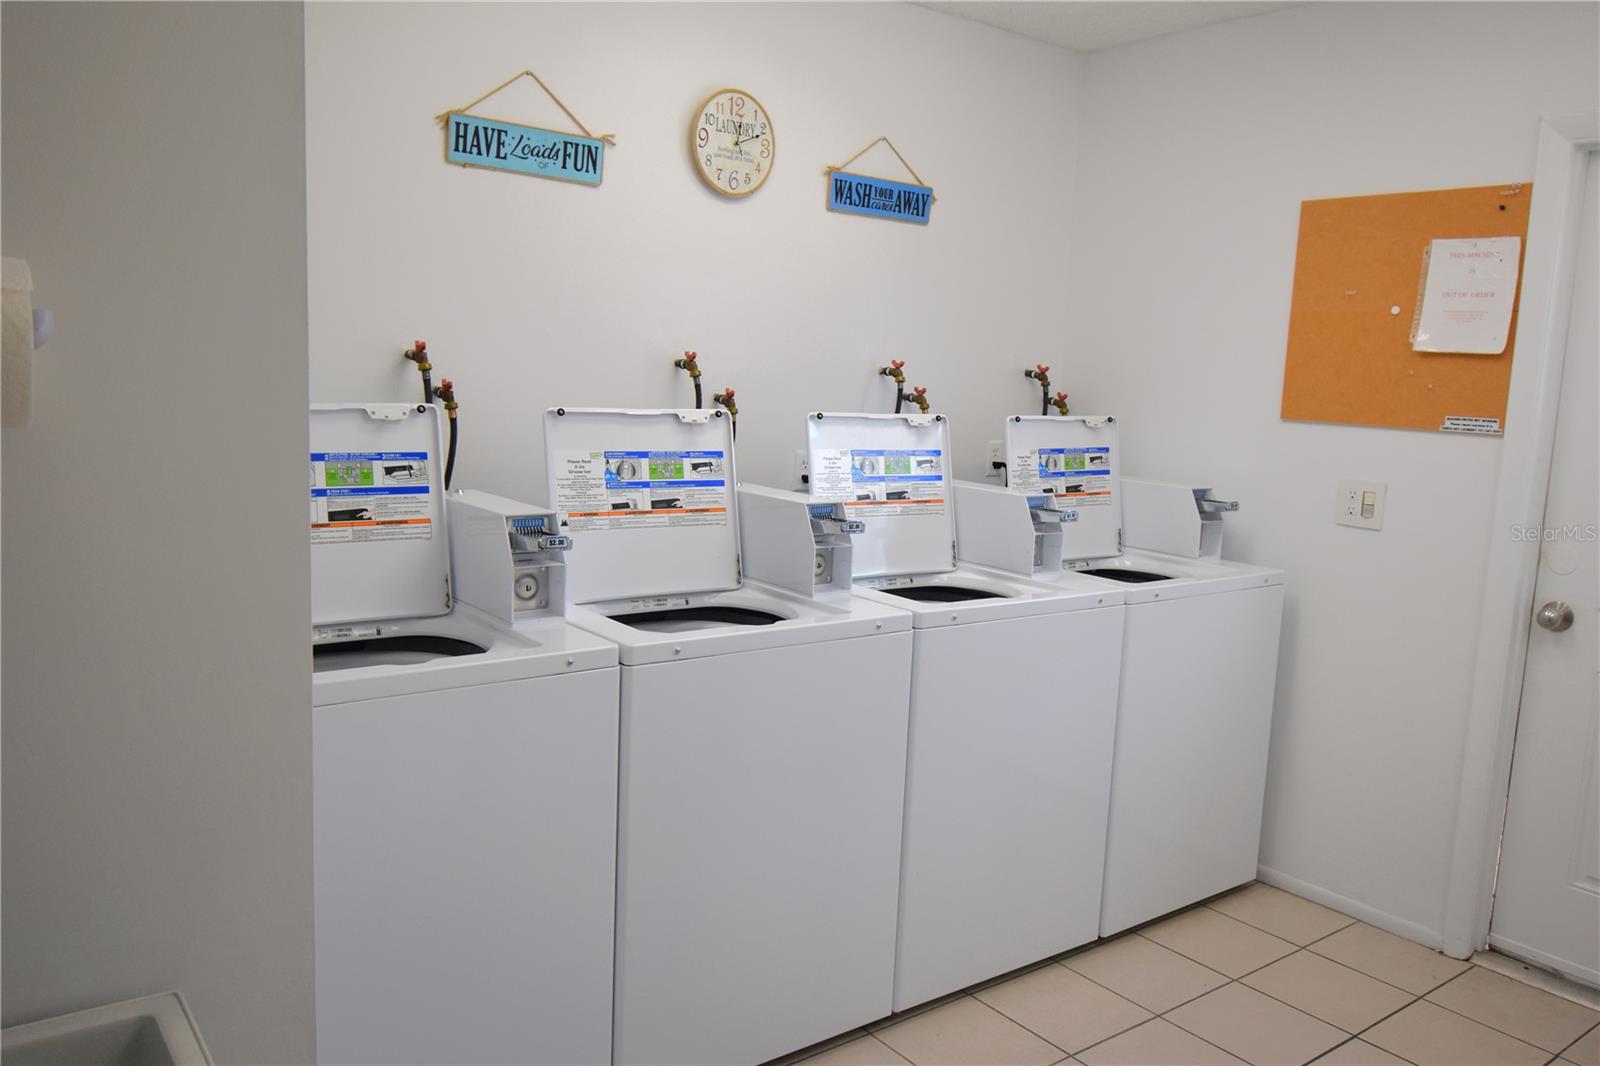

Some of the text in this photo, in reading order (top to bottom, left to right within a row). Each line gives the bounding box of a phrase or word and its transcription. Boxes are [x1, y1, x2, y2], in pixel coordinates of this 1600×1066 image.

[716, 102, 724, 115] 11
[728, 96, 746, 118] 12
[704, 113, 715, 126] 10
[754, 110, 758, 121] 1
[716, 117, 757, 138] LAUNDRY
[760, 122, 767, 135] 2
[698, 128, 709, 149] 9
[453, 121, 509, 161] HAVE
[510, 134, 561, 161] Loads
[561, 140, 600, 175] FUN
[760, 138, 770, 159] 3
[705, 154, 713, 167] 8
[755, 161, 761, 174] 4
[717, 168, 723, 181] 7
[728, 171, 739, 190] 6
[744, 173, 751, 185] 5
[834, 178, 873, 209] WASH
[874, 186, 894, 201] YOUR
[894, 190, 930, 217] AWAY
